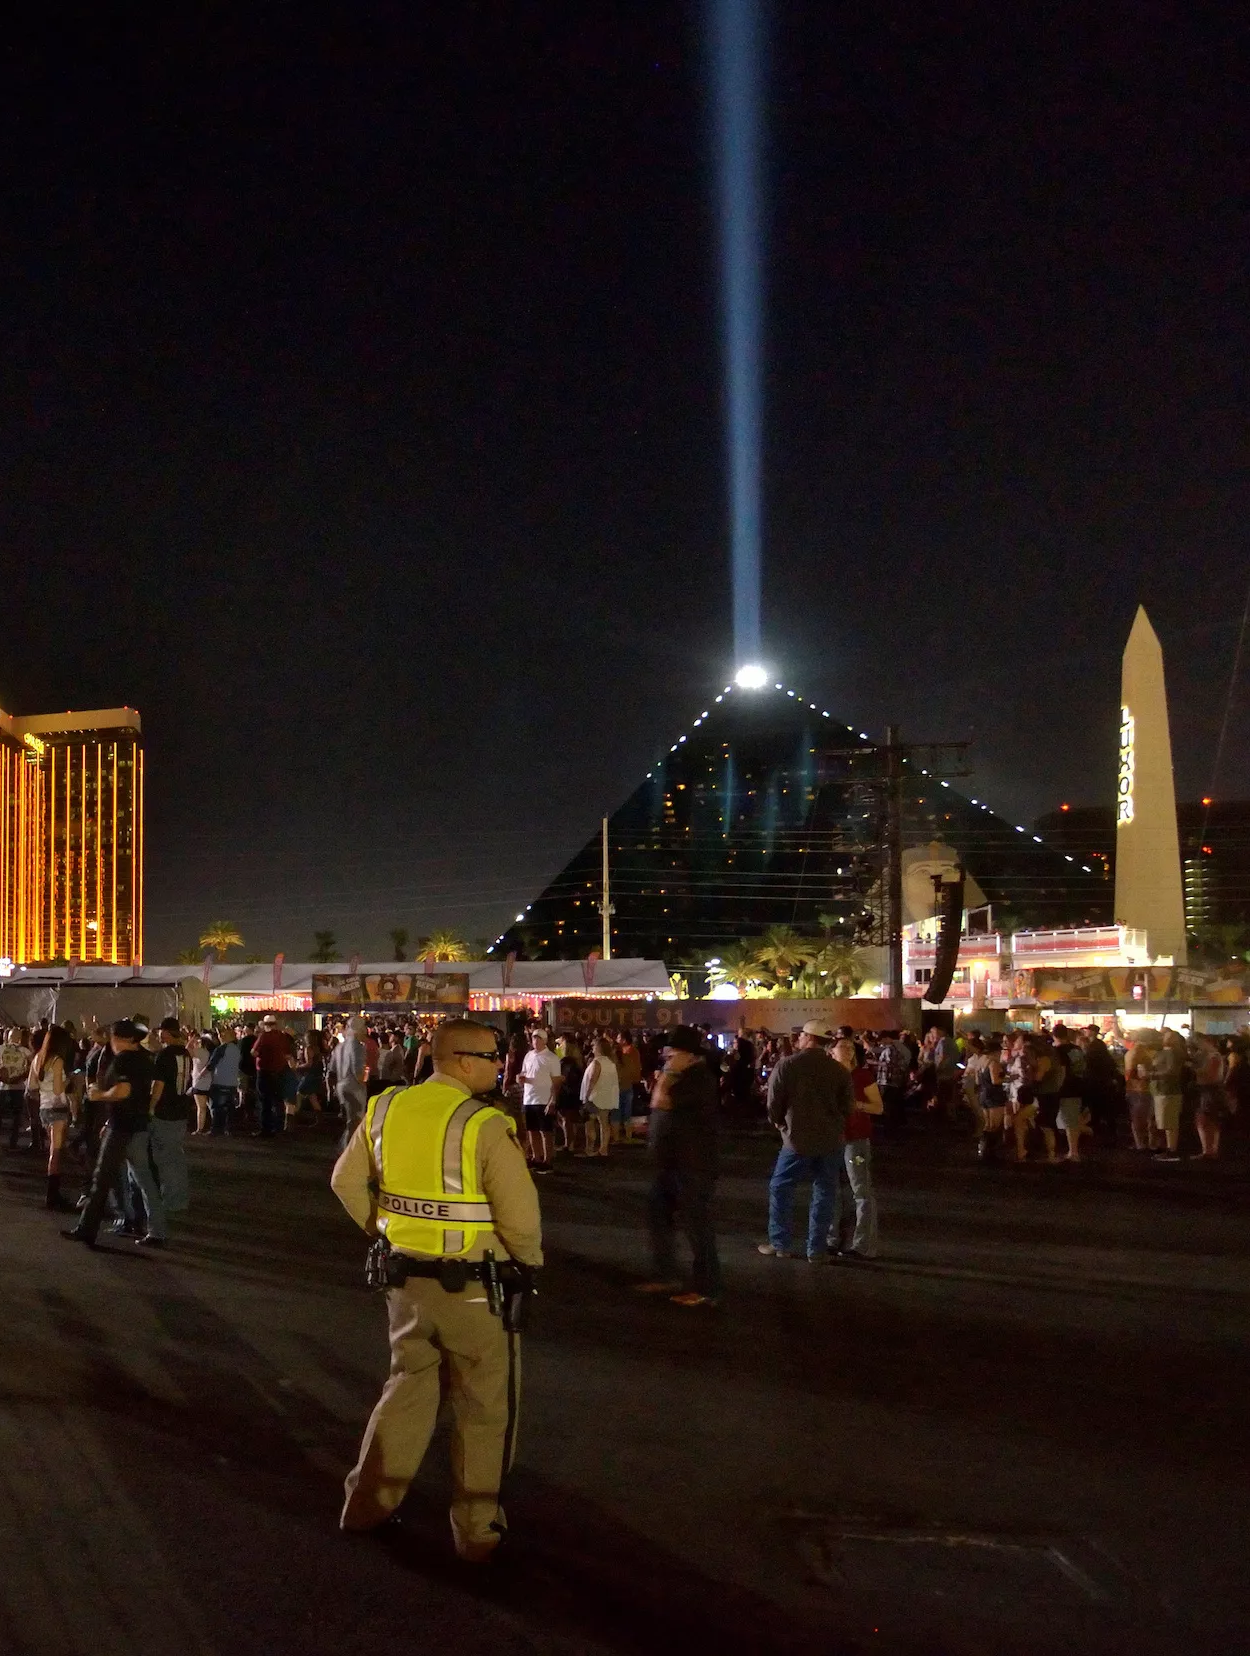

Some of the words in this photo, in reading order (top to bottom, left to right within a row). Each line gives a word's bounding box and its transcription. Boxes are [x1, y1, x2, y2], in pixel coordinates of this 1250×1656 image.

[1118, 705, 1134, 825] LUXOR
[557, 1007, 647, 1026] ROUTE
[656, 1007, 684, 1026] 91
[383, 1197, 450, 1217] POLICE
